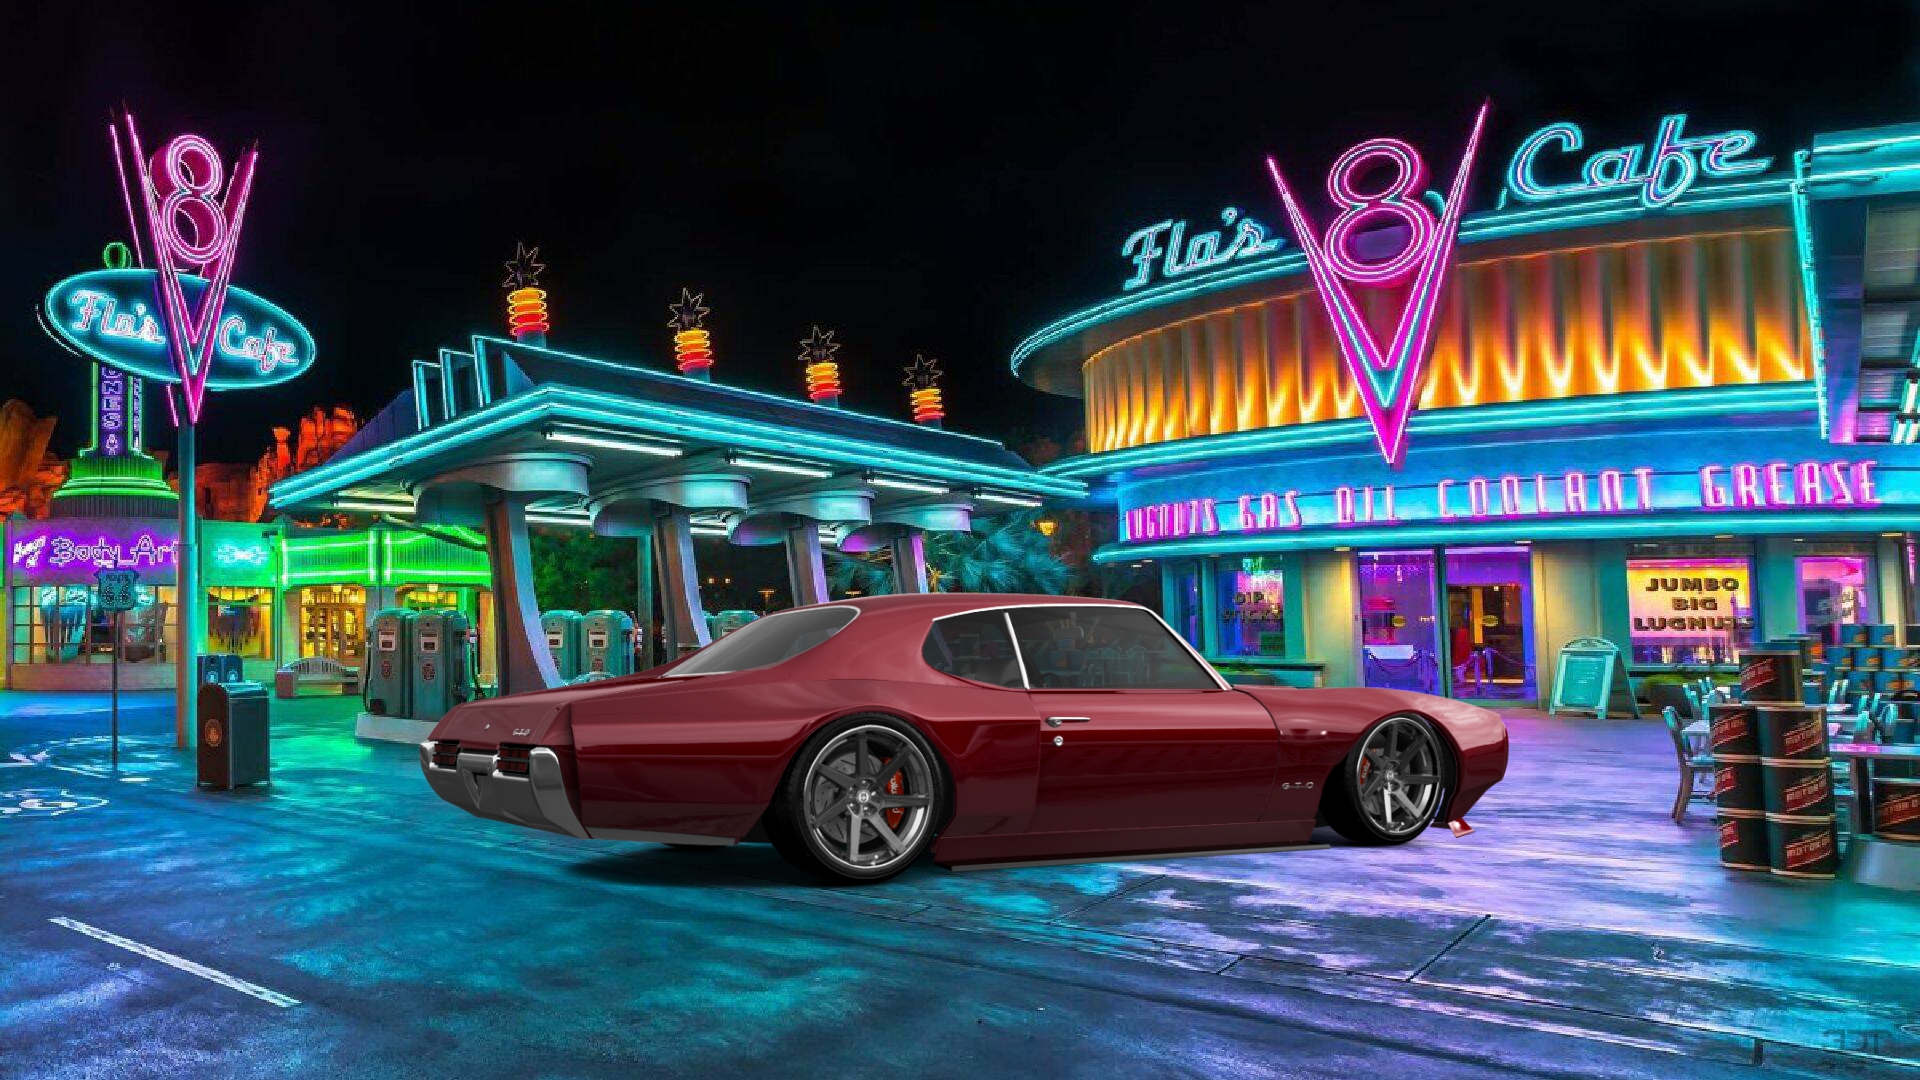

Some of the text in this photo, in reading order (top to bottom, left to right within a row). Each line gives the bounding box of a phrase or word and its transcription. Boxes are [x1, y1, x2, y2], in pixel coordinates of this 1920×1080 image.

[1120, 206, 1286, 292] Flo's
[1508, 112, 1774, 208] Cafe
[71, 288, 166, 345] Flo's
[219, 315, 299, 374] Cafe
[1238, 488, 1302, 530] GAS
[1335, 485, 1400, 524] OIL
[1437, 466, 1654, 519] COOLANT
[1700, 459, 1882, 509] GREASE
[1645, 577, 1740, 592] JUMBO
[1671, 596, 1718, 611] BIG
[1281, 781, 1315, 790] GTO
